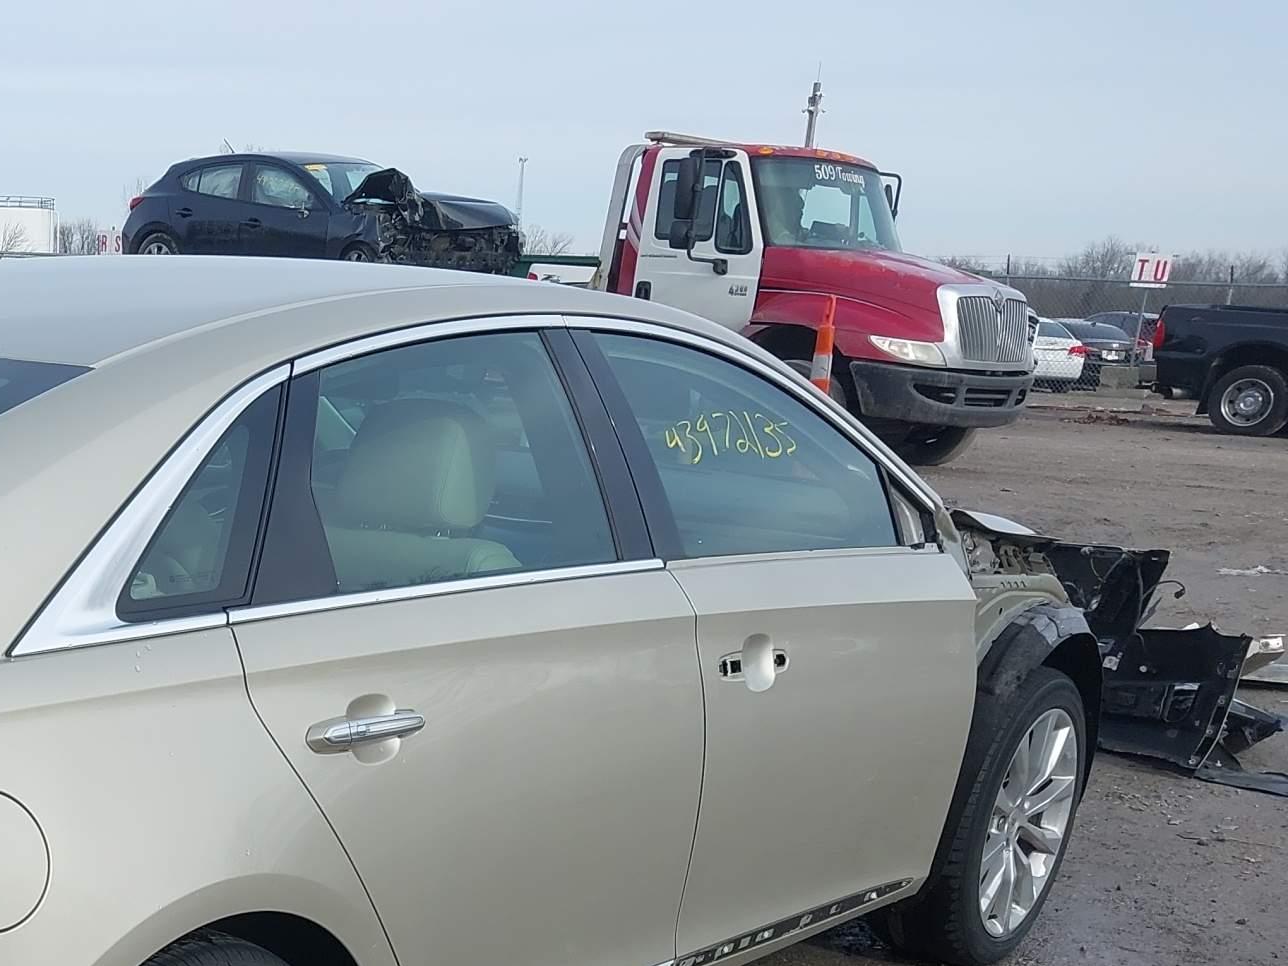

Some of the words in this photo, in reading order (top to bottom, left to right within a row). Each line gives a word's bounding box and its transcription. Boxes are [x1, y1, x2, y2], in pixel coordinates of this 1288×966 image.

[814, 164, 836, 181] 509
[836, 166, 865, 188] Towing
[665, 410, 797, 464] 43972135
